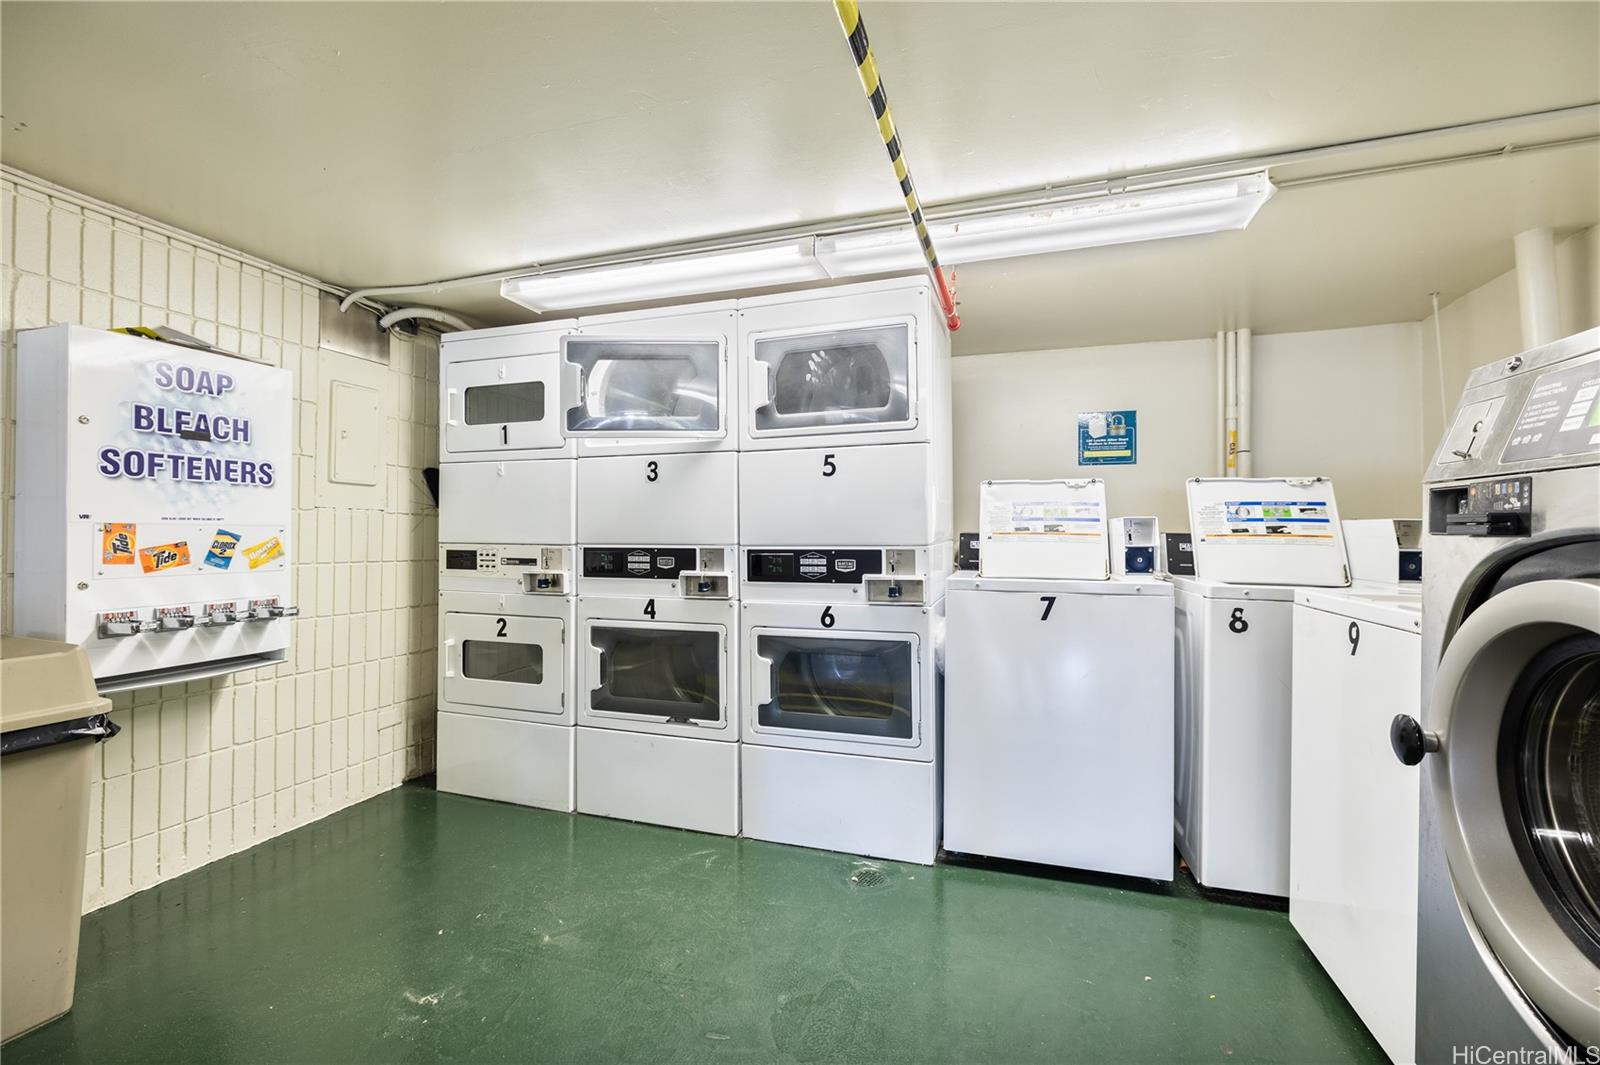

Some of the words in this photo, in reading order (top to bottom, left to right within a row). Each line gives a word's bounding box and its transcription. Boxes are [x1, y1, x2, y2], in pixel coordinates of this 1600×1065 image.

[154, 362, 233, 396] SOAP
[133, 403, 250, 443] BLEACH
[501, 425, 508, 445] 1
[99, 448, 274, 485] SOFTENERS
[646, 461, 659, 482] 3
[822, 454, 837, 477] 5
[112, 533, 133, 554] Tide
[153, 551, 178, 568] Tide
[643, 599, 657, 619] 4
[820, 605, 836, 628] 6
[1040, 596, 1056, 621] 7
[496, 617, 508, 638] 2
[1229, 607, 1249, 634] 8
[1348, 621, 1360, 656] 9
